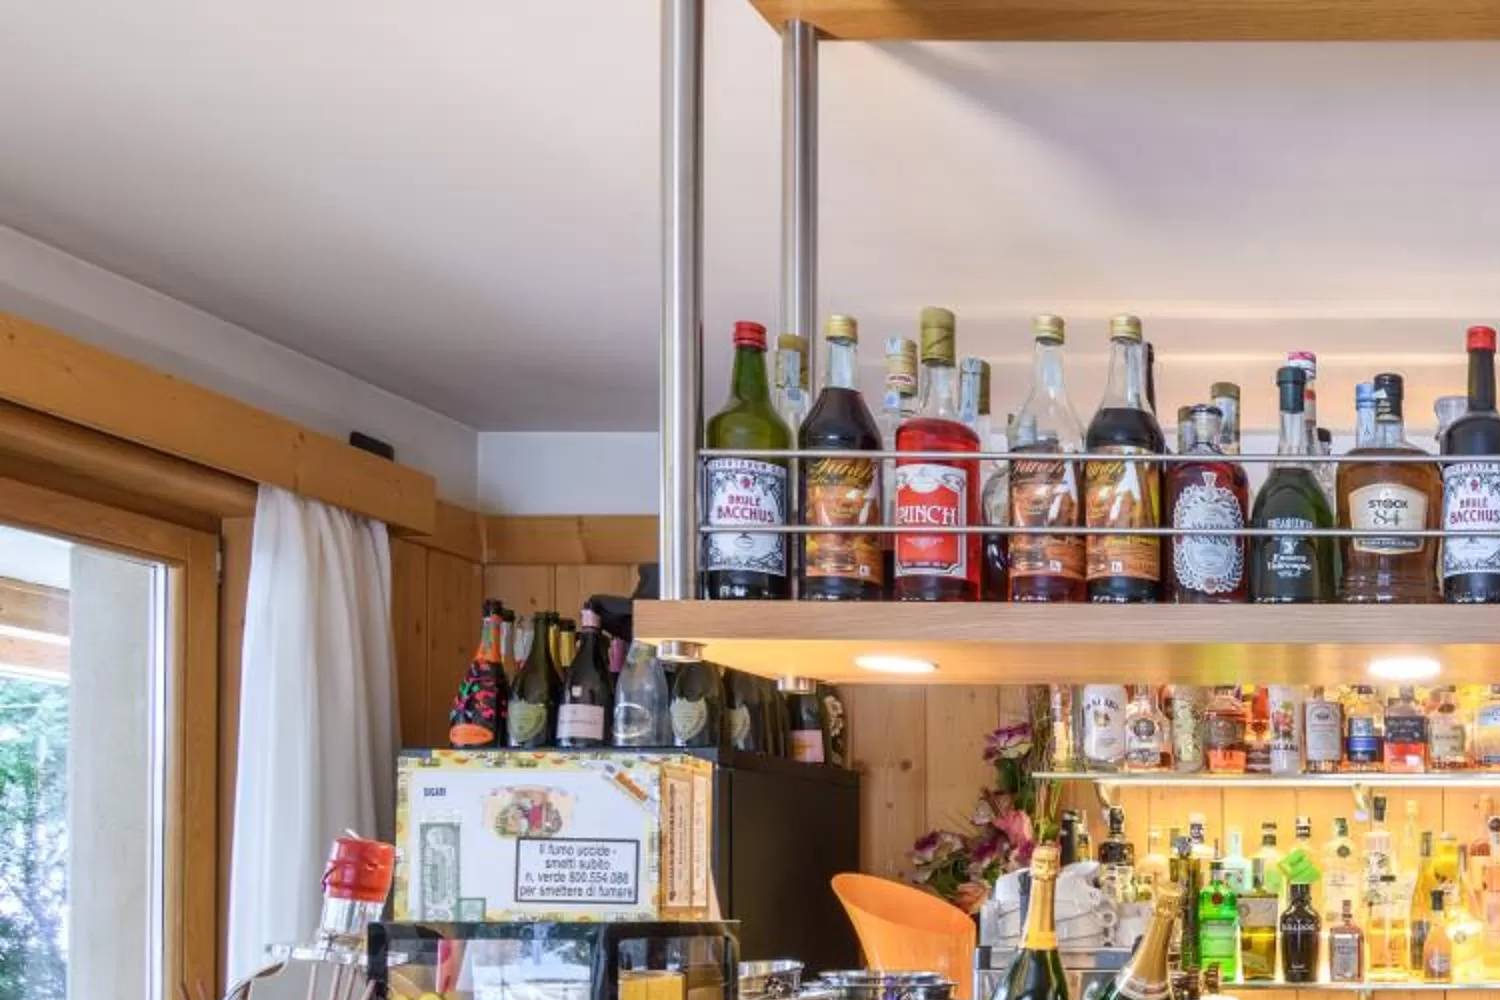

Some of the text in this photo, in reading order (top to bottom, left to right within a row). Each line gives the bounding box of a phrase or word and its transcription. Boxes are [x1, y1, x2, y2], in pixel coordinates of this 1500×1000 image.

[1367, 499, 1409, 509] STOCK
[717, 506, 775, 523] BACCHUS
[896, 505, 957, 525] PUNCH
[1450, 509, 1500, 525] BACCHUS
